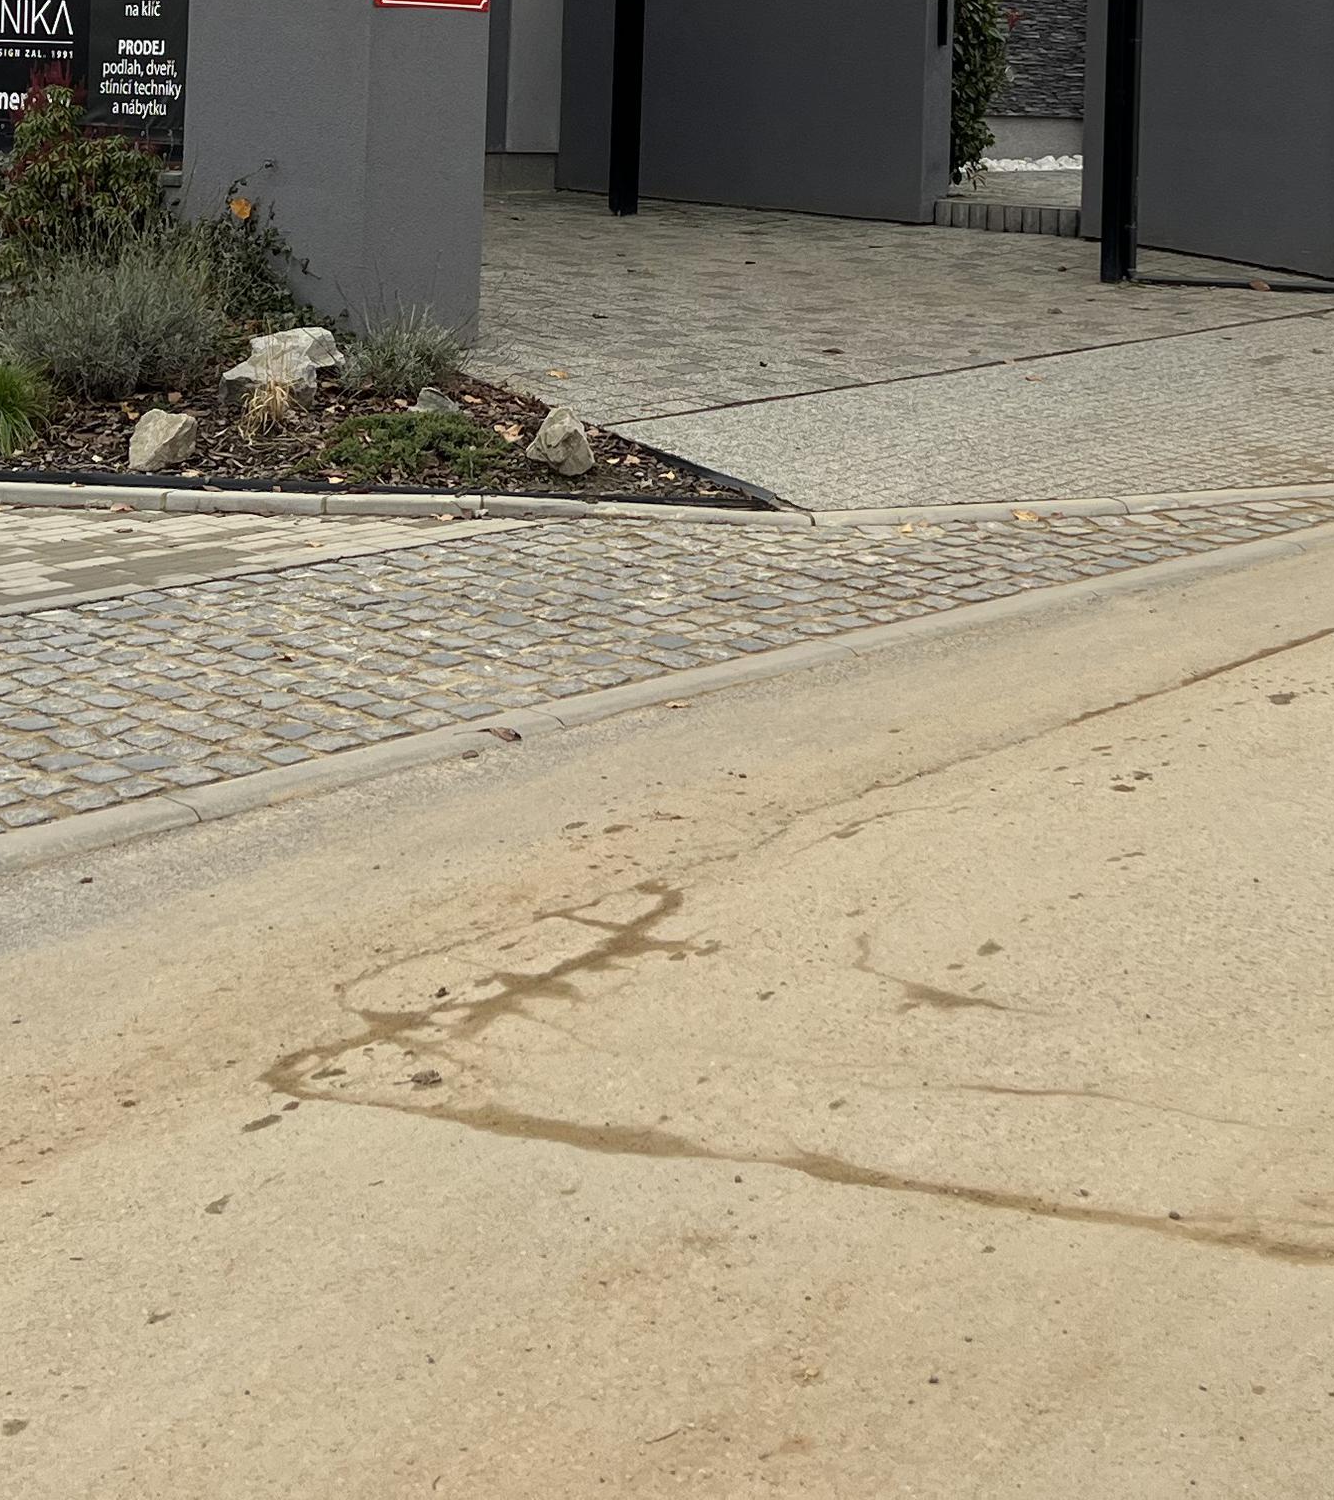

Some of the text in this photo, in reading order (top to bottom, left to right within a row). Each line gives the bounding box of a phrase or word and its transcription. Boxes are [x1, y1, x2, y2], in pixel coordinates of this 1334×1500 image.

[125, 0, 162, 17] na klíč
[50, 50, 74, 59] 1991
[118, 39, 165, 56] PRODEJ
[102, 58, 178, 78] podlah, dveří,
[99, 78, 183, 101] stínící techniky
[112, 98, 167, 120] a nábytku
